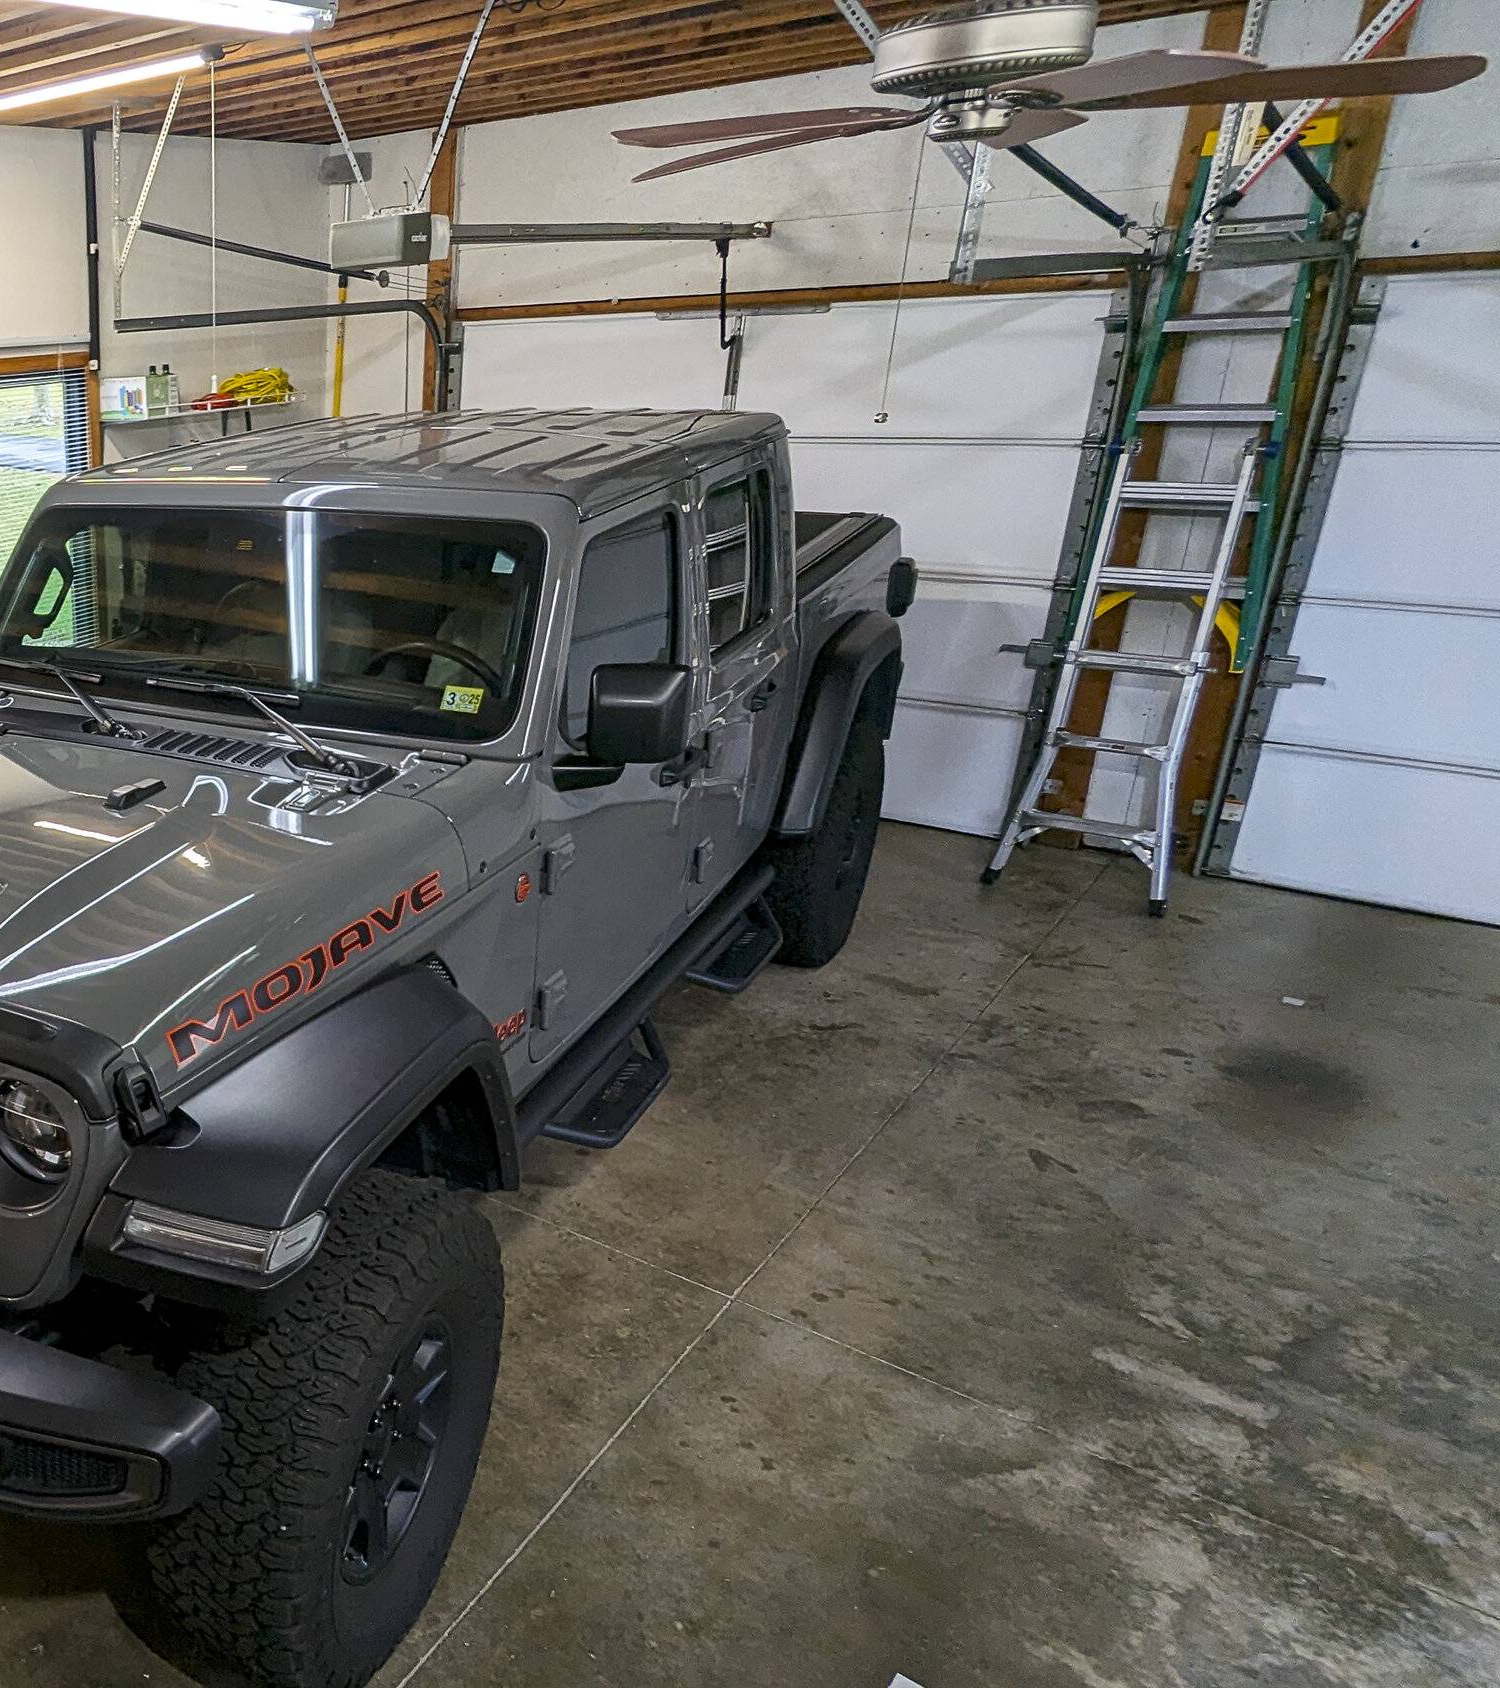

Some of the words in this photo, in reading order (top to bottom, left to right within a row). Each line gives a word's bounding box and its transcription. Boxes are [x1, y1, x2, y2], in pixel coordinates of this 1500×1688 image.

[446, 692, 456, 705] 3
[468, 693, 481, 705] 25
[165, 870, 444, 1070] MOJAVE
